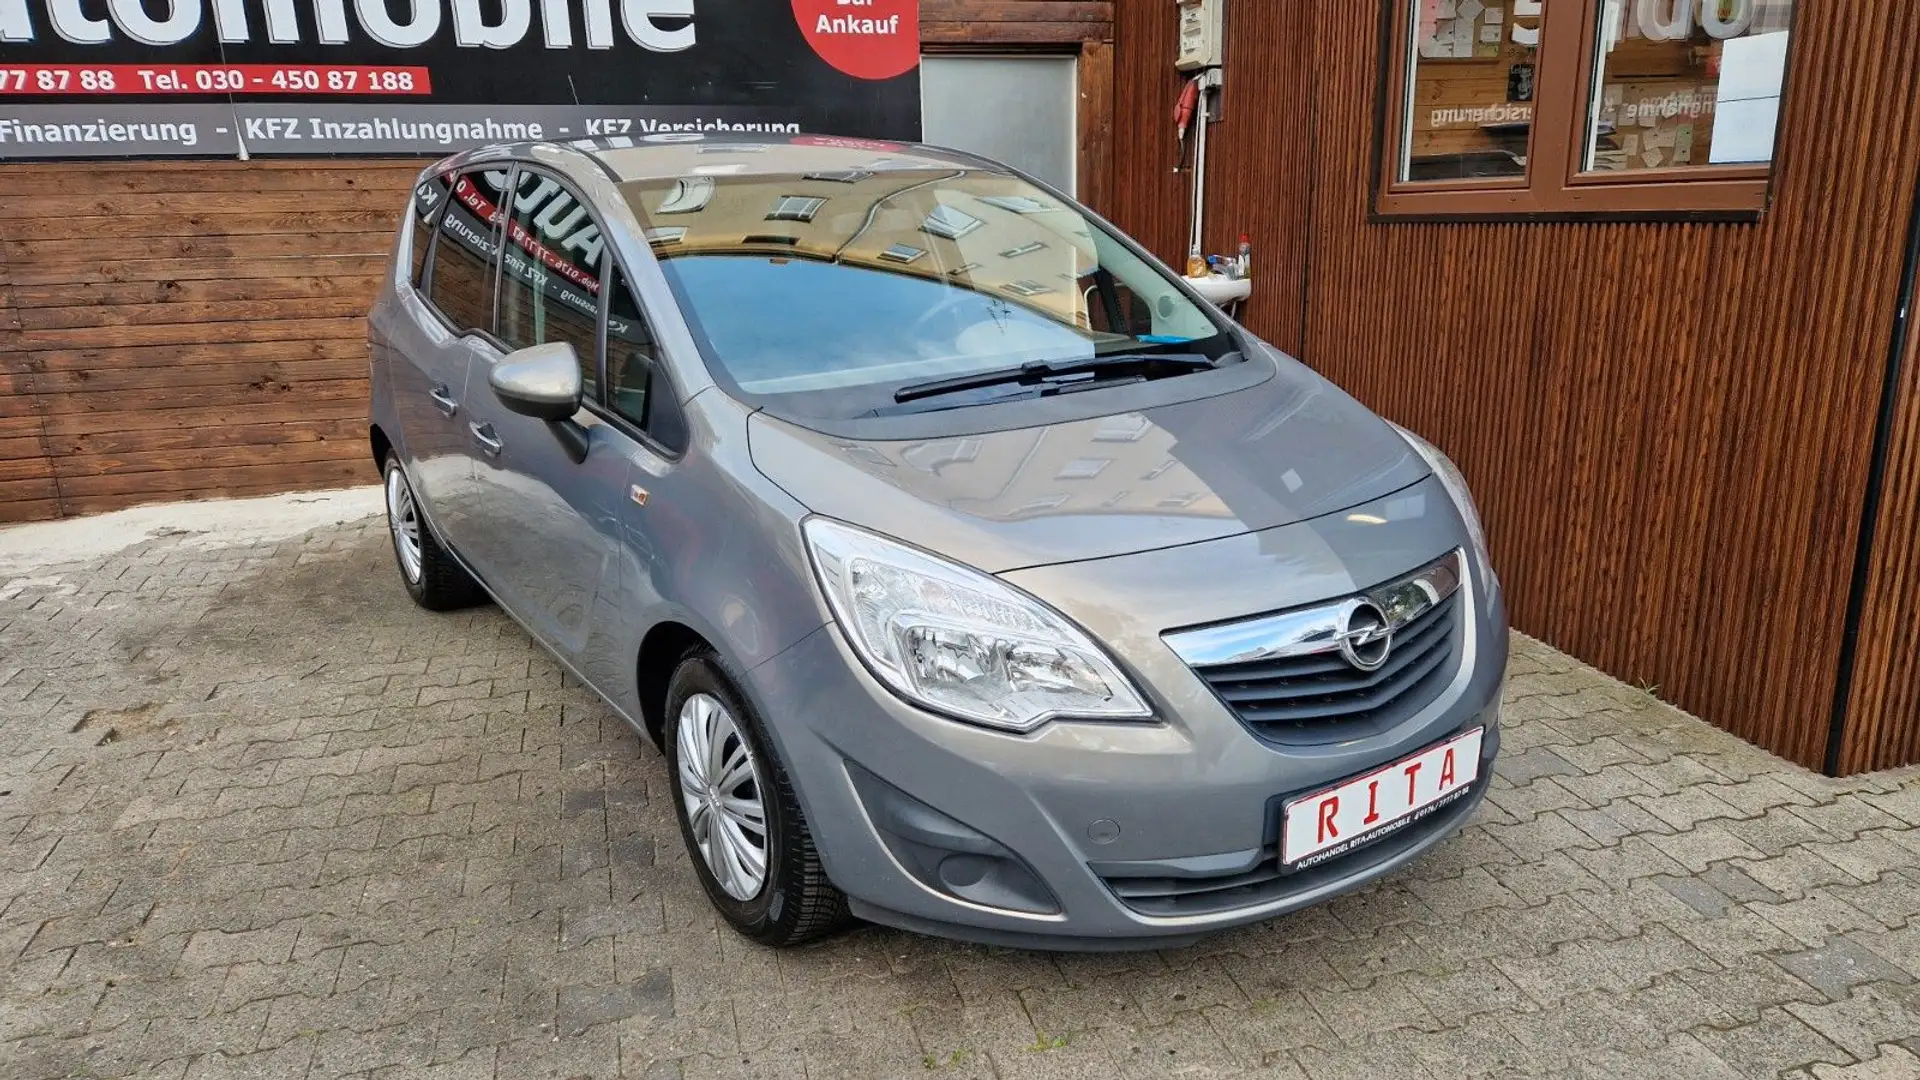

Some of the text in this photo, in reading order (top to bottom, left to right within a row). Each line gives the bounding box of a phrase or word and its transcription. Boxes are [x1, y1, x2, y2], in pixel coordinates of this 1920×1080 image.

[815, 14, 899, 34] Ankauf
[36, 70, 70, 90] 87
[80, 70, 116, 90] 88
[138, 70, 188, 90] Tel.
[196, 70, 244, 90] 030
[272, 70, 319, 90] 450
[328, 71, 358, 90] 87
[368, 71, 414, 91] 188
[0, 118, 197, 146] Finanzierung
[245, 118, 301, 140] KFZ
[309, 117, 543, 144] Inzahlungnahme
[585, 118, 633, 136] KFZ
[1296, 843, 1349, 870] AUTOHANDEL
